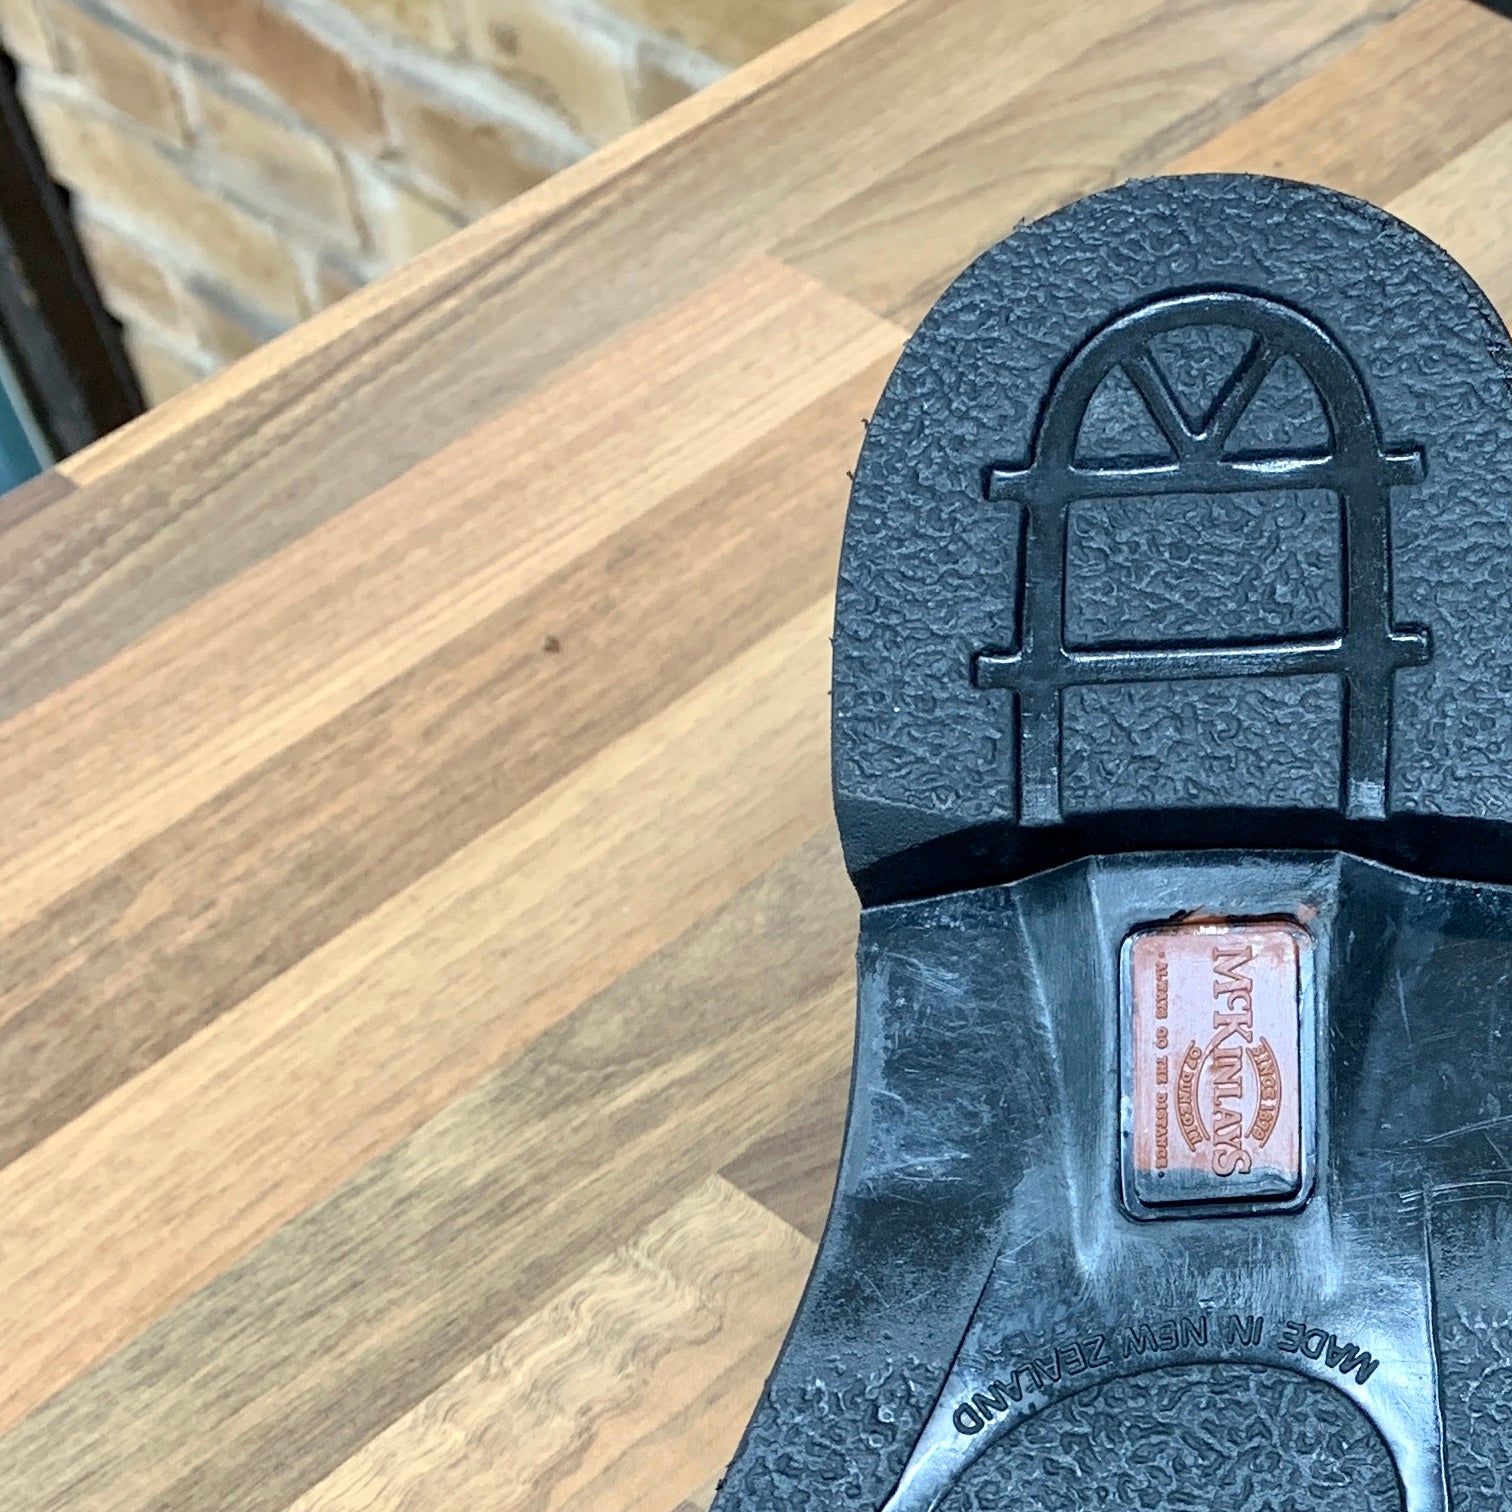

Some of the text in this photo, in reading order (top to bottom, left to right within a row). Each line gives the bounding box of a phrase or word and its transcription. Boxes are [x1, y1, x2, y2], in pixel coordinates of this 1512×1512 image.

[1155, 960, 1169, 1169] ALWAYS GO THE DISTANCE
[1178, 1045, 1204, 1146] OF DUNEDIN
[1250, 1046, 1277, 1102] SINCE
[952, 1314, 1379, 1436] MADE IN NEW ZEALAND
